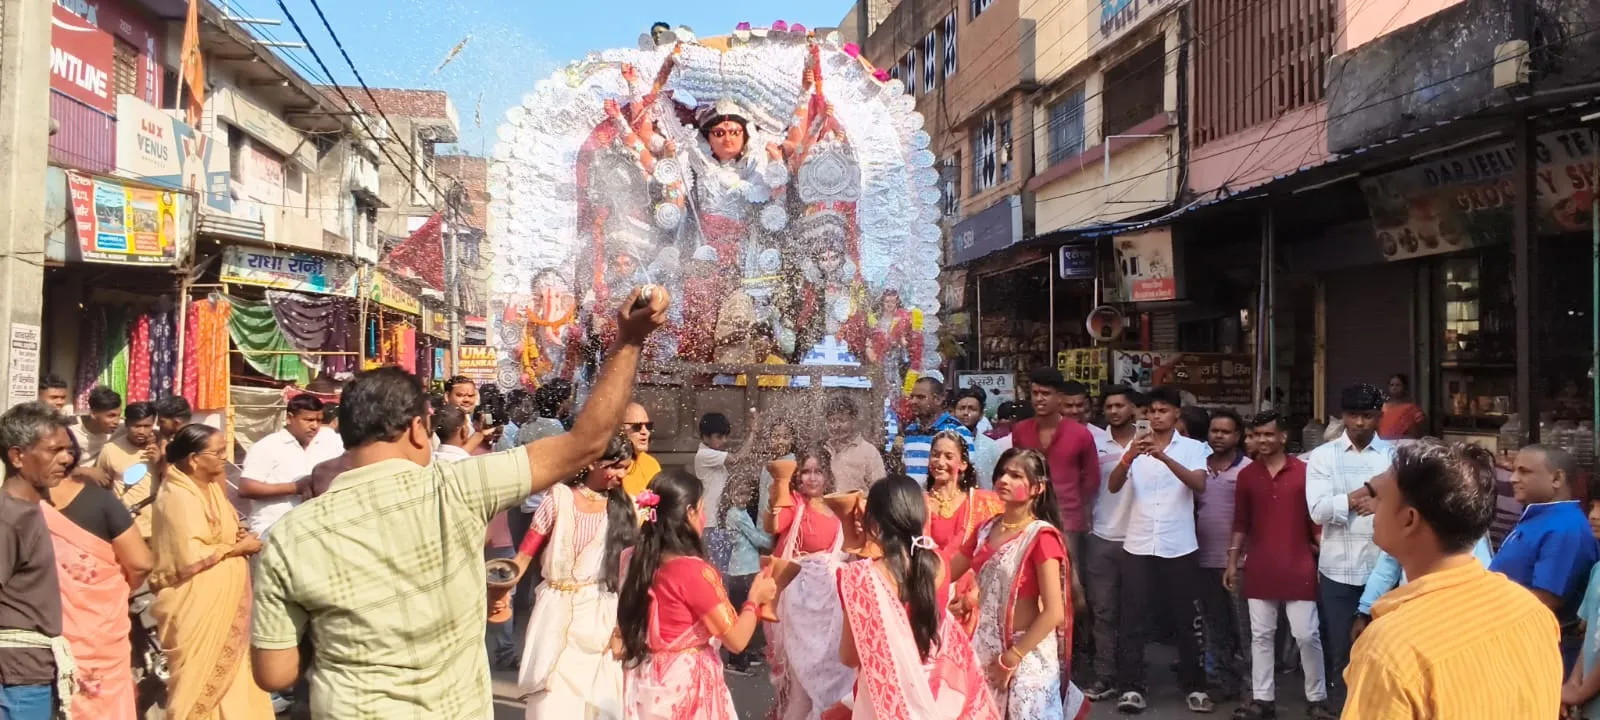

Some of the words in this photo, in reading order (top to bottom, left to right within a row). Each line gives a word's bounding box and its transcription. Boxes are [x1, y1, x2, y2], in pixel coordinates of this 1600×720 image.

[141, 118, 164, 139] LUX
[137, 132, 168, 161] VENUS
[1424, 140, 1552, 187] DARJEELIG
[1456, 170, 1557, 211] GROCY
[247, 253, 284, 271] राधा
[461, 346, 497, 360] UMA
